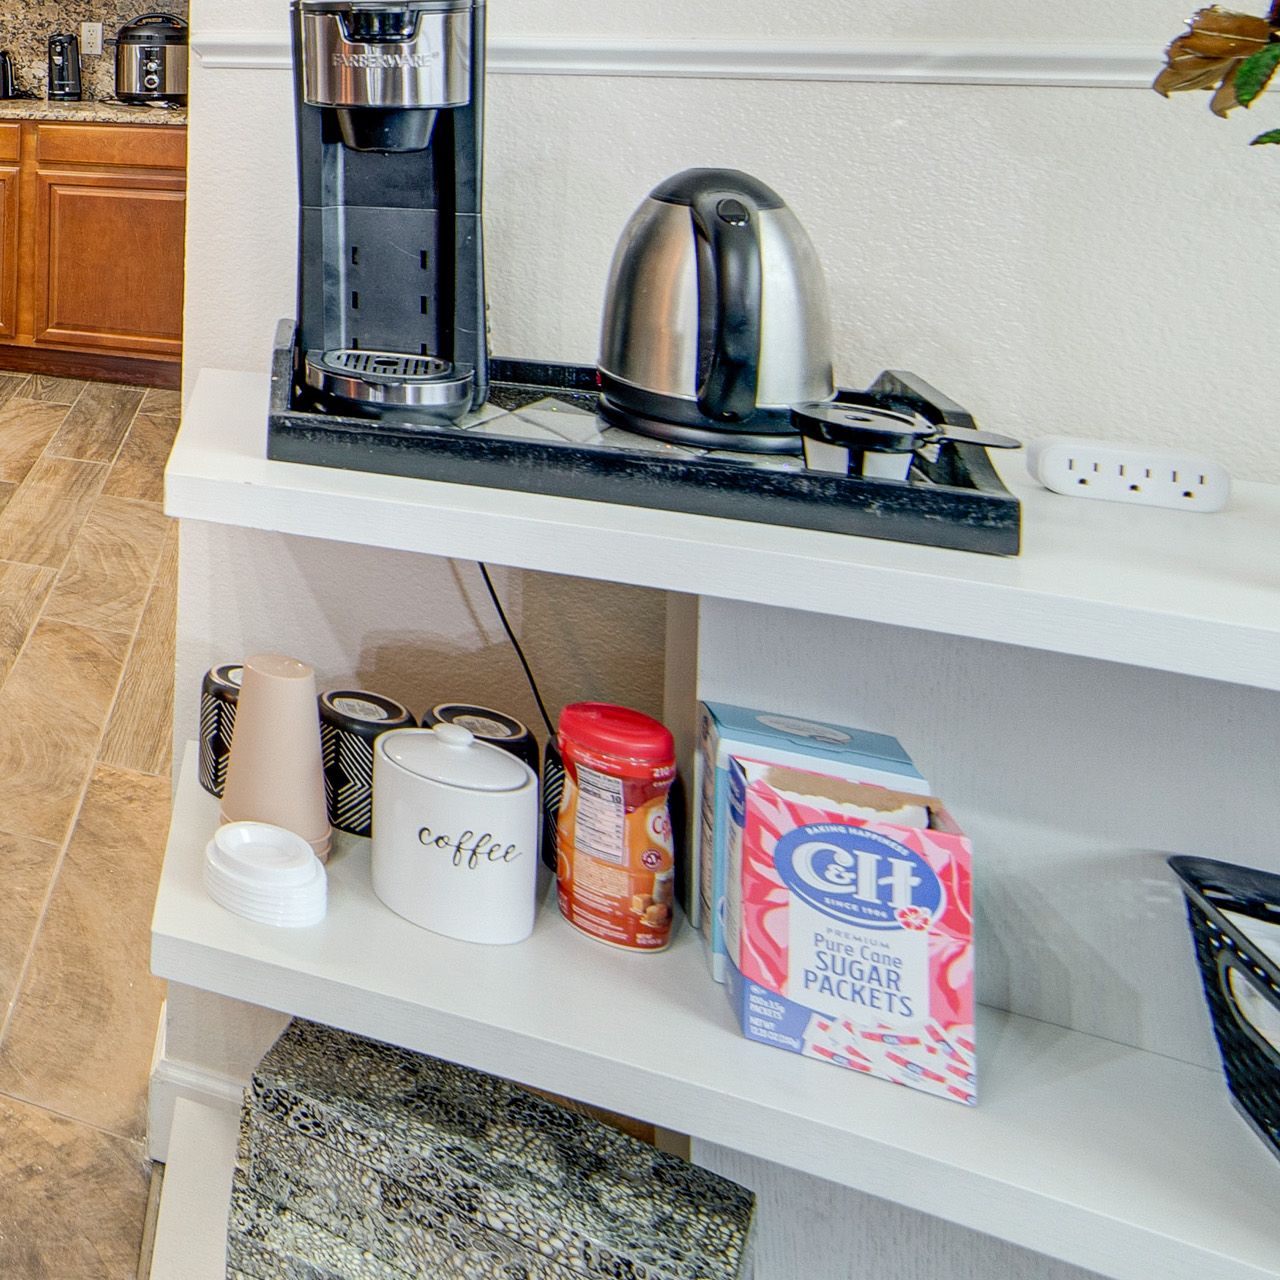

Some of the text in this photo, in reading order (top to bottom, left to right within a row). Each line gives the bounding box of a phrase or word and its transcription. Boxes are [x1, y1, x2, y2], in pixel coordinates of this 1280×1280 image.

[332, 53, 433, 68] FARBERWARE
[419, 827, 522, 870] coffee
[805, 824, 911, 856] BAKING HAPPINESS
[792, 841, 922, 909] C&H
[823, 897, 860, 912] SINCE
[814, 932, 903, 969] Pure Cane
[826, 927, 891, 949] PREMIUM
[815, 950, 901, 992] SUGAR
[803, 969, 914, 1018] PACKETS
